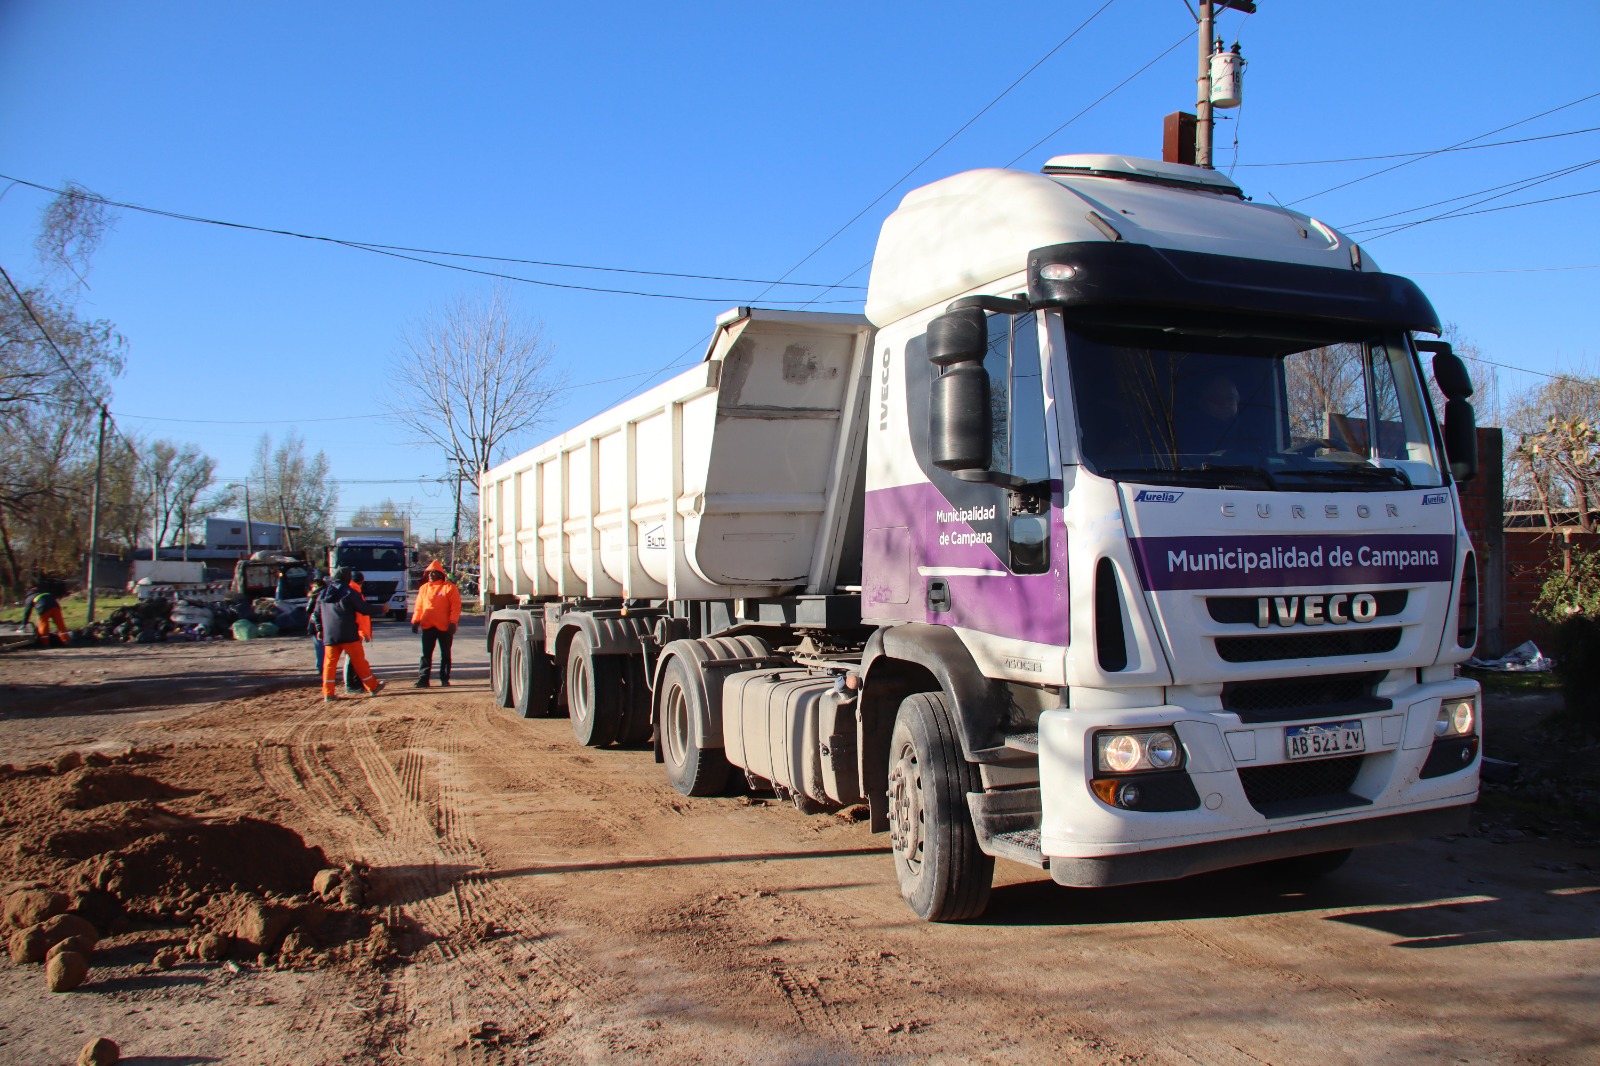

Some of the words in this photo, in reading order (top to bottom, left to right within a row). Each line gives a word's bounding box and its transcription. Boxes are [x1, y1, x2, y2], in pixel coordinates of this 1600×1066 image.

[879, 347, 891, 431] IVECO
[1134, 490, 1175, 502] Aurelia
[1421, 494, 1444, 506] Aurelia
[936, 505, 996, 524] Municipalidad
[1220, 502, 1399, 519] CURSOR
[939, 533, 949, 546] de
[951, 531, 993, 547] Campana
[1168, 545, 1323, 574] Municipalidad
[1330, 546, 1353, 568] de
[1358, 546, 1440, 571] Campana
[1257, 593, 1378, 628] IVECO
[1292, 736, 1308, 755] AB
[1313, 733, 1340, 753] 521
